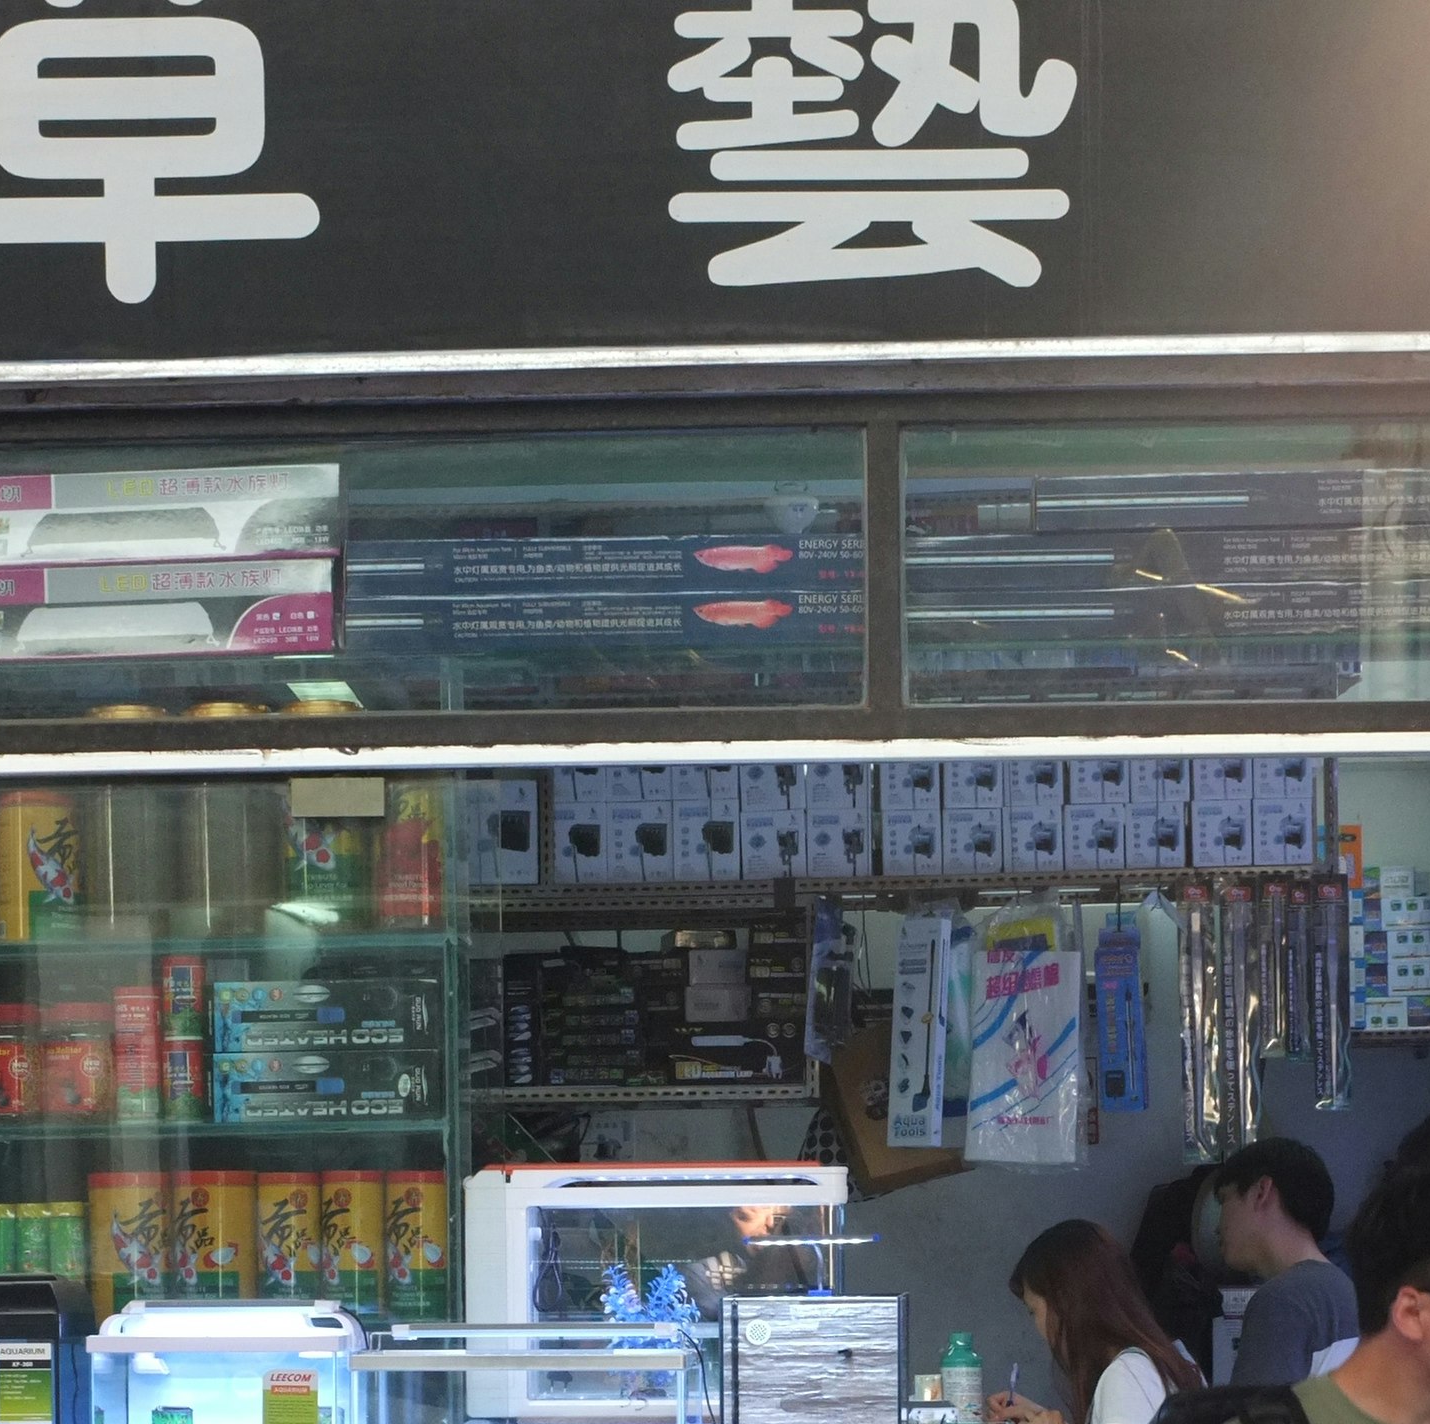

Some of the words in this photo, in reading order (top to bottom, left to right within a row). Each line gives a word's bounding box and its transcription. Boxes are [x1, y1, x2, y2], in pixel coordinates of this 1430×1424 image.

[799, 540, 837, 550] ENERGY
[841, 539, 864, 549] SERI
[840, 551, 864, 559] 50-60
[799, 595, 836, 605] ENERGY
[841, 594, 864, 604] SERI
[352, 1028, 404, 1044] ECO
[352, 1099, 404, 1115] ECO
[893, 1114, 926, 1128] Aqua
[893, 1126, 927, 1138] Tools
[0, 1348, 46, 1356] AQUARIUM
[270, 1373, 312, 1382] LEECOM
